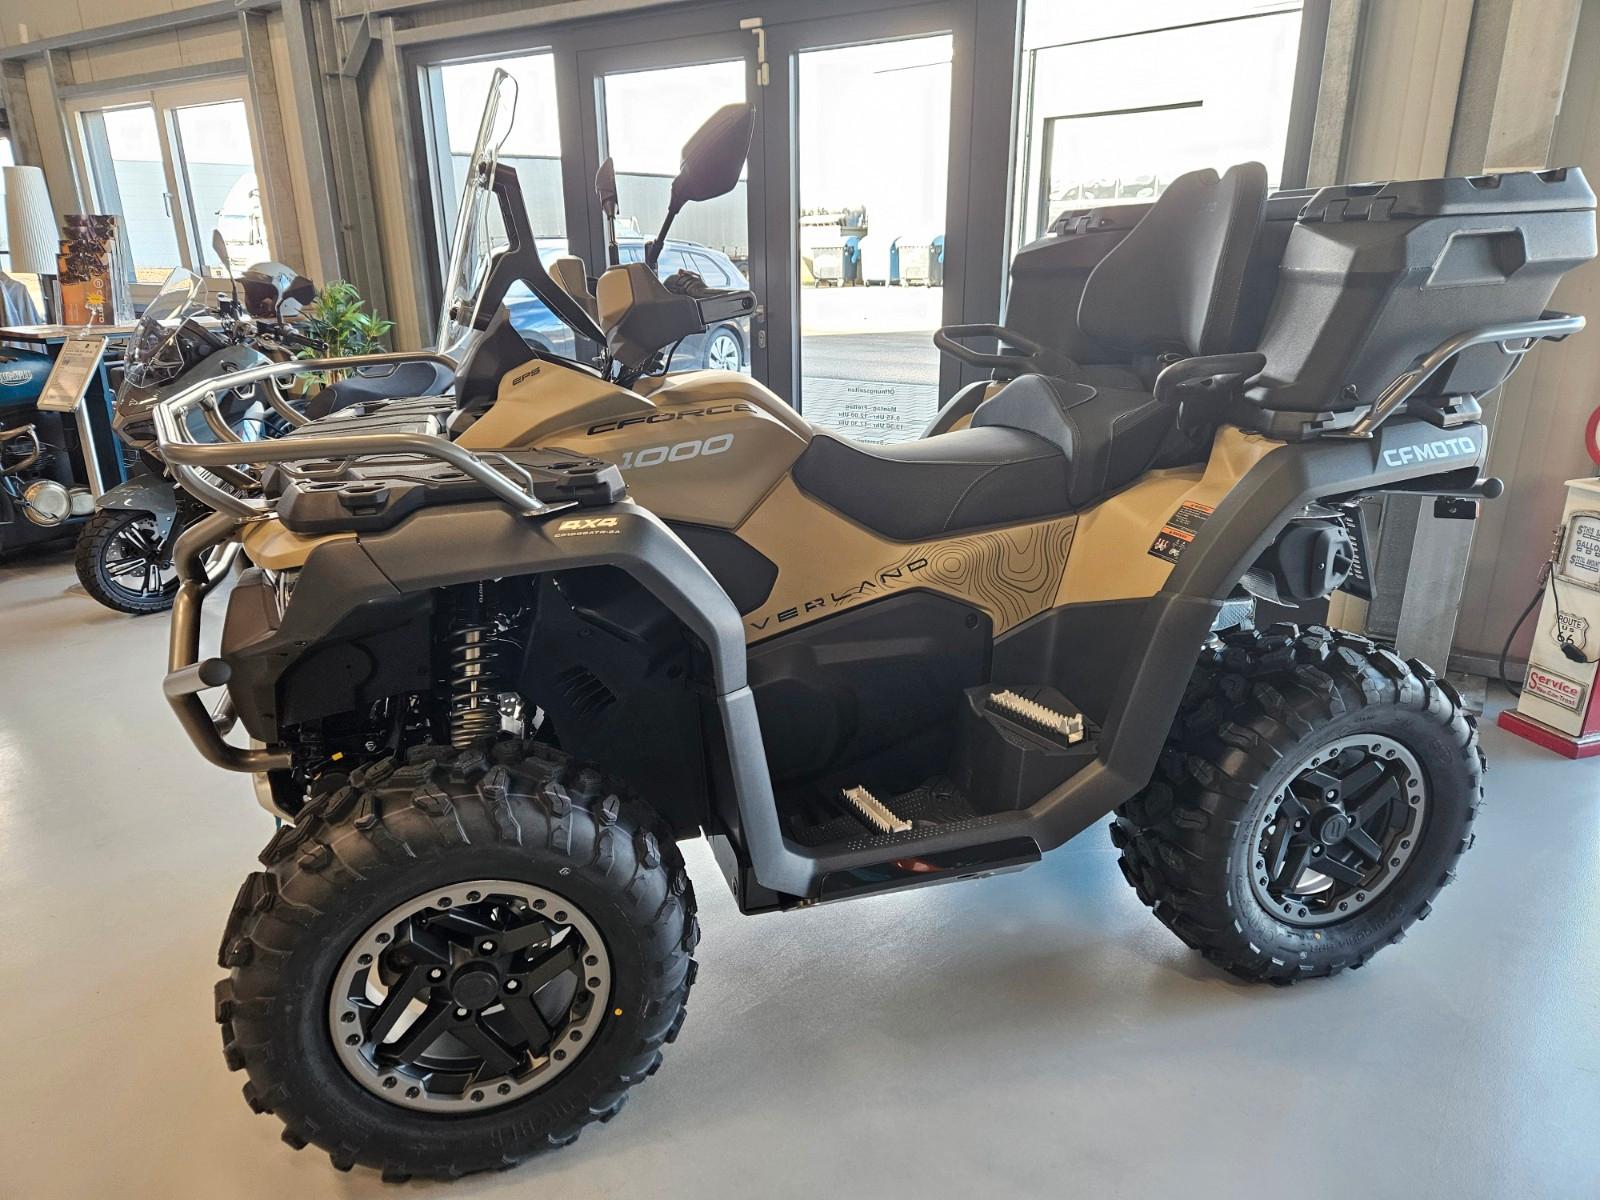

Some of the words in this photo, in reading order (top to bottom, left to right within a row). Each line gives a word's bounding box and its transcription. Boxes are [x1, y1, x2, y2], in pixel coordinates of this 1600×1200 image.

[512, 366, 541, 386] EPS
[586, 403, 758, 436] CFORCE
[619, 433, 735, 470] 1000
[1383, 436, 1476, 467] CFMOTO
[1576, 540, 1600, 551] GALLO
[750, 557, 929, 631] VERLAND
[1558, 614, 1582, 629] ROUTE
[1529, 671, 1578, 696] Service
